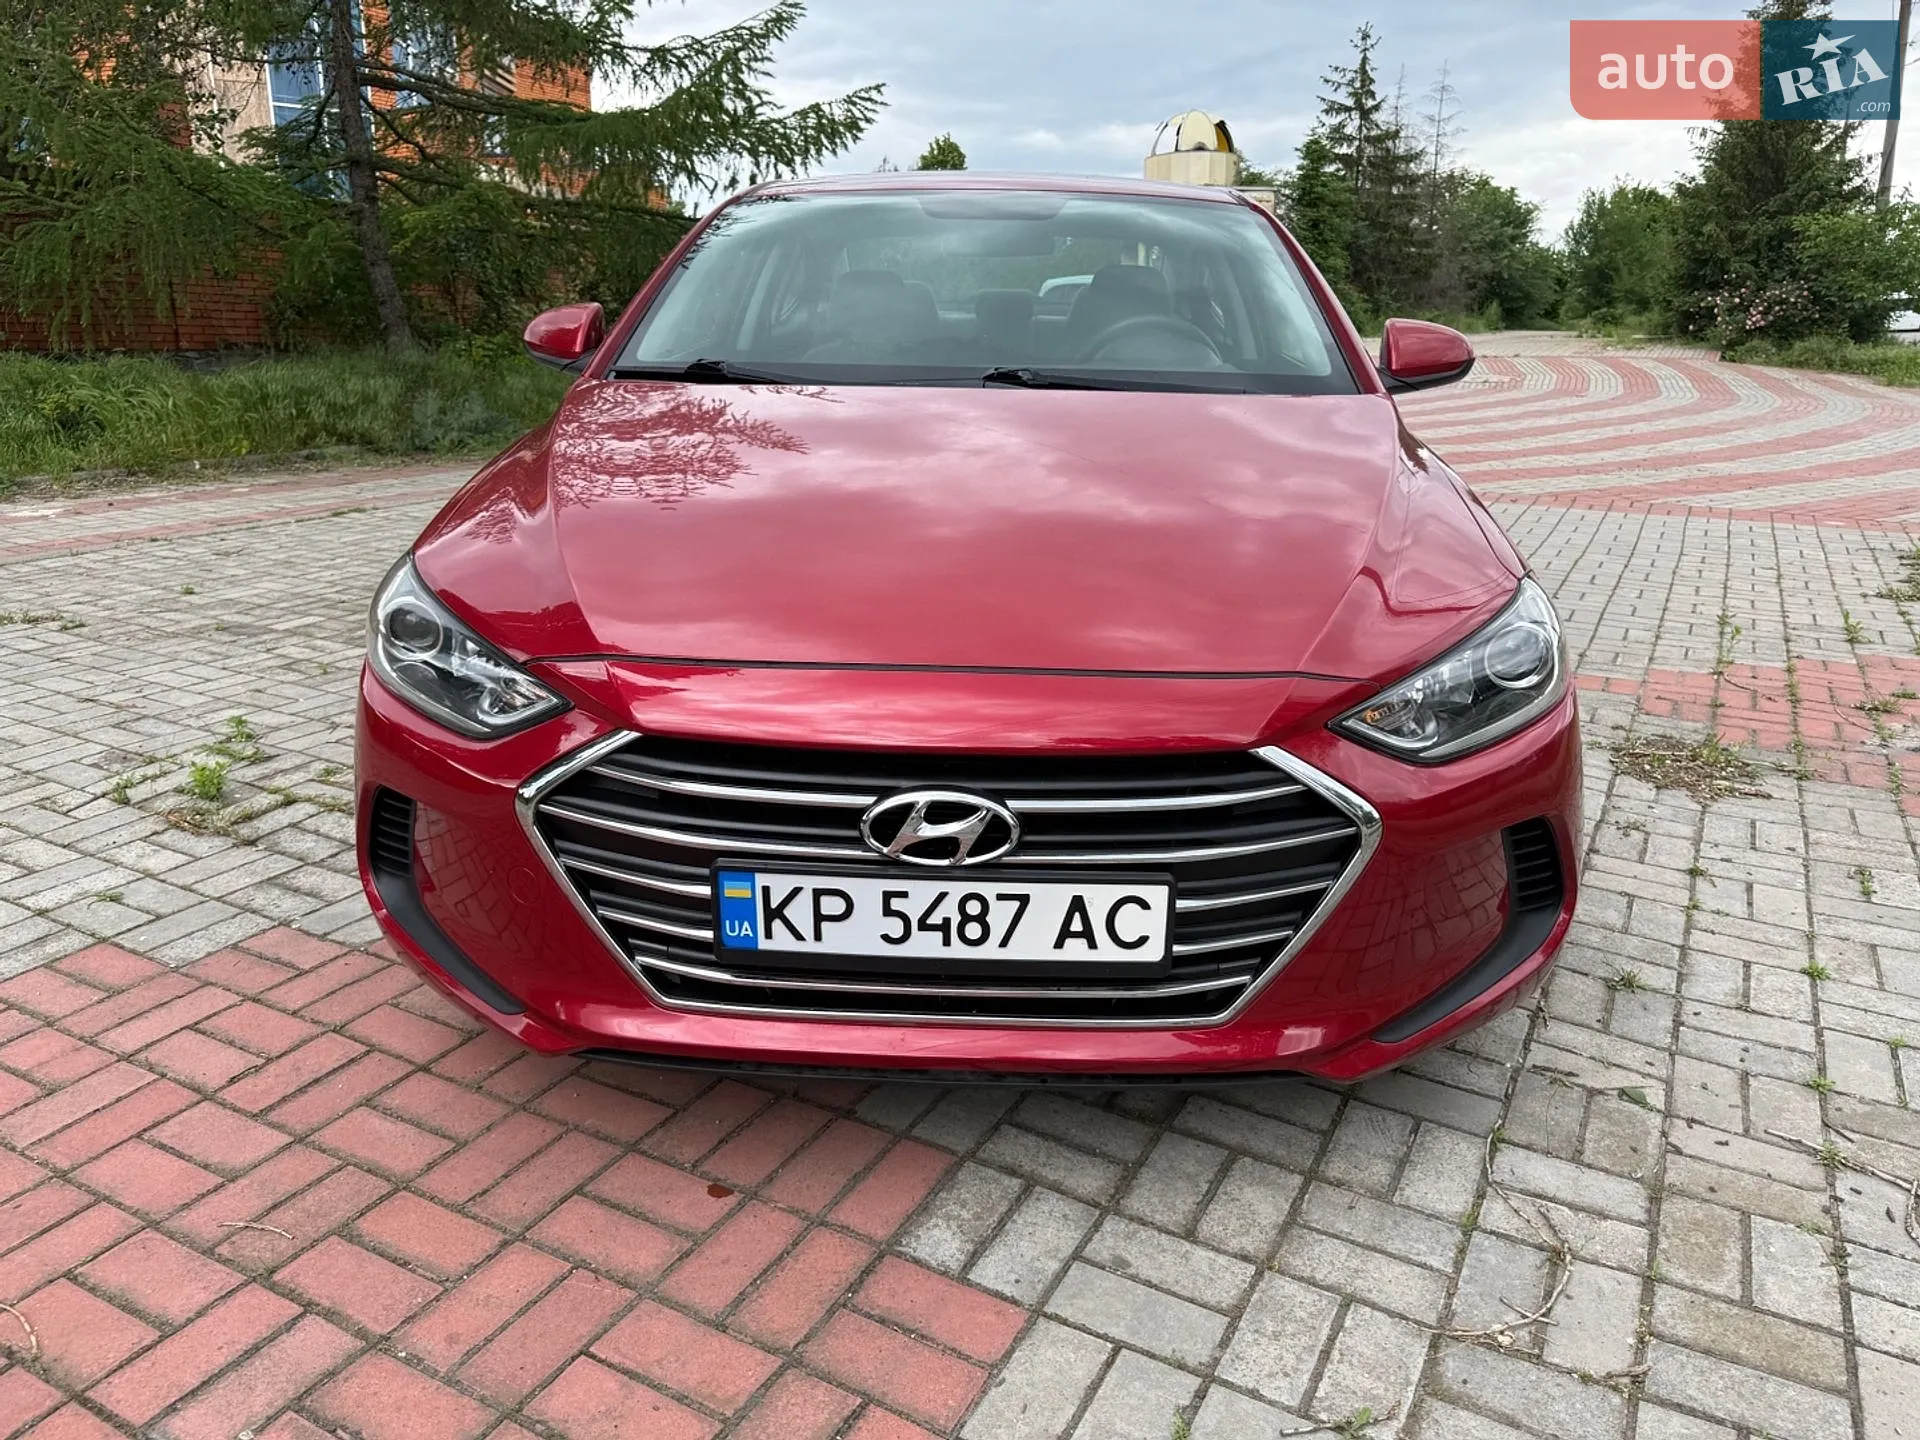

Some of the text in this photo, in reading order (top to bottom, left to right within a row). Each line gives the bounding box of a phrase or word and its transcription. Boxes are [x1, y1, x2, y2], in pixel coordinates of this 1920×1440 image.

[725, 919, 754, 938] UA
[761, 885, 1152, 950] KP 5487 AC
